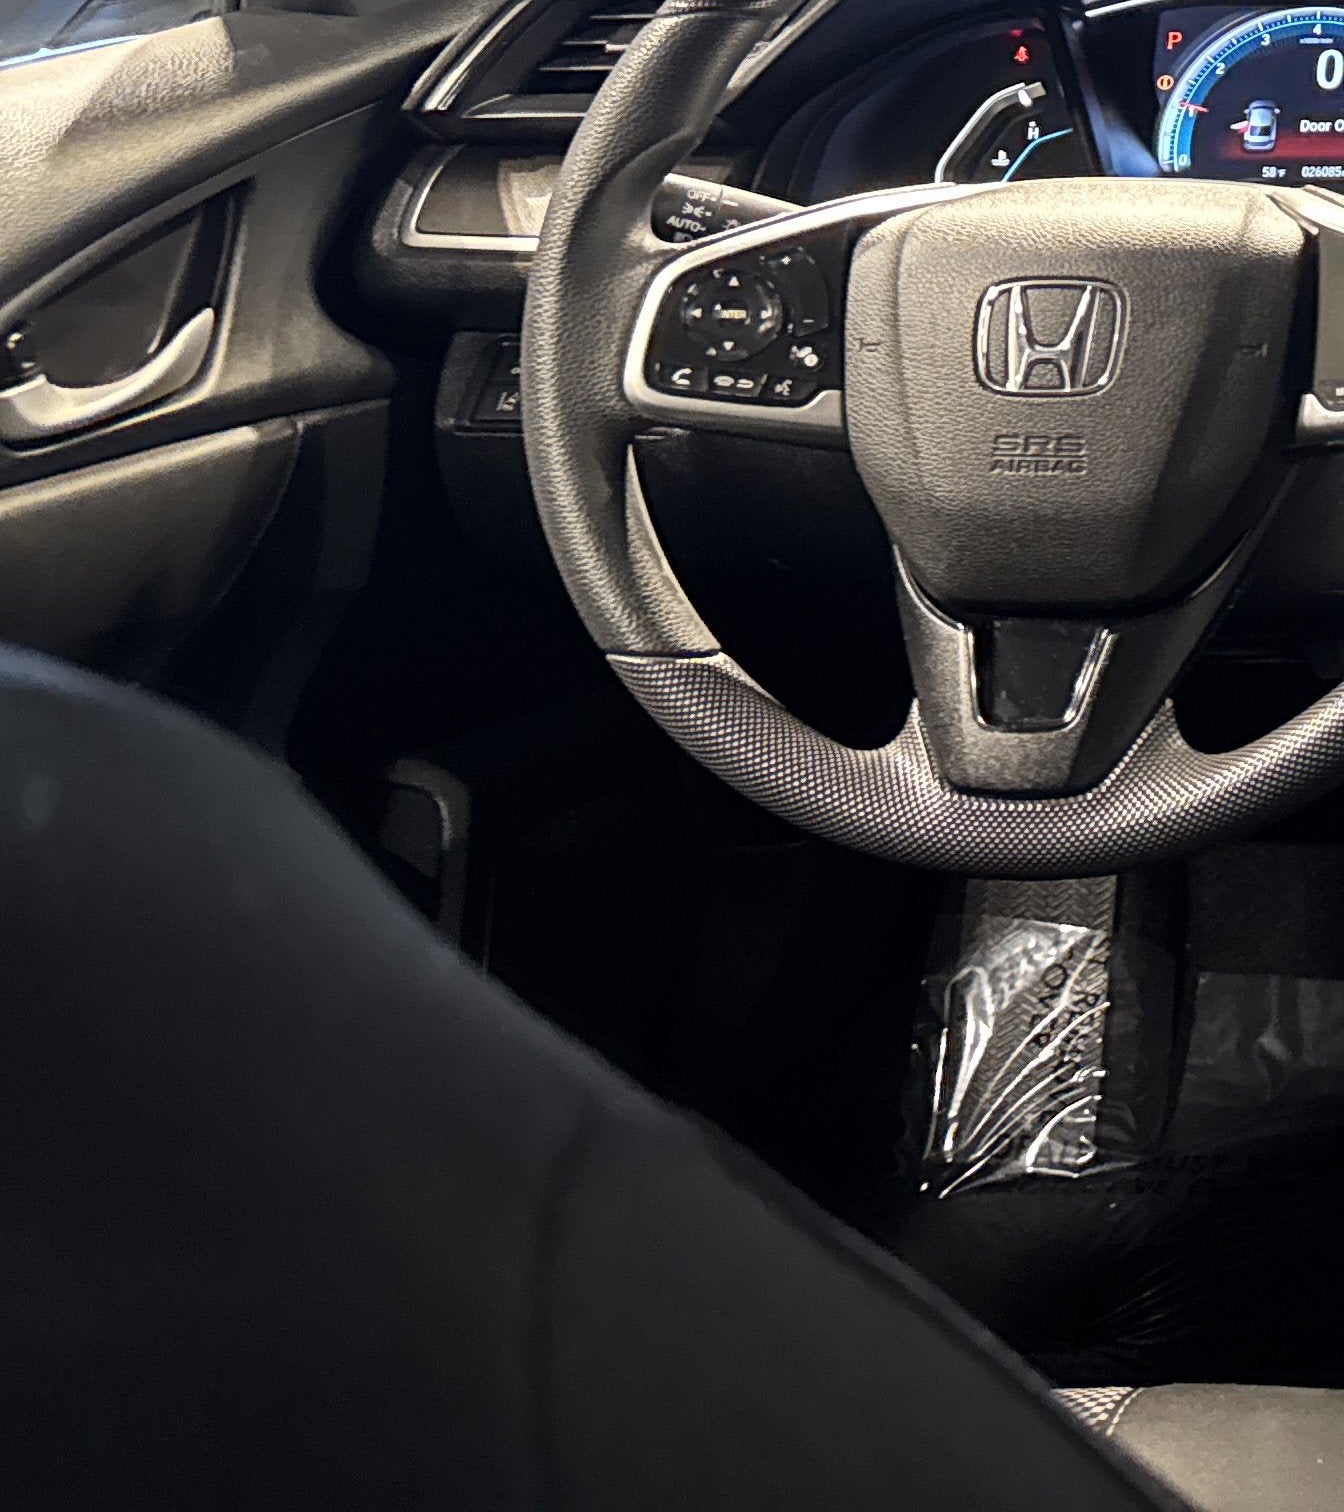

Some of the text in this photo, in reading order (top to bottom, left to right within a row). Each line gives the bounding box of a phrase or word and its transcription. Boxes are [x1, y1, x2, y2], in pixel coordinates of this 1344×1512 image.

[1312, 23, 1323, 36] 4
[1166, 31, 1184, 50] P
[1260, 33, 1272, 47] 3
[1214, 61, 1226, 76] 2
[1315, 48, 1344, 91] 0
[1298, 119, 1333, 134] Door
[1177, 152, 1189, 167] 0
[666, 214, 701, 233] AUTO
[992, 433, 1088, 456] SRS
[989, 459, 1088, 477] AIRBAG
